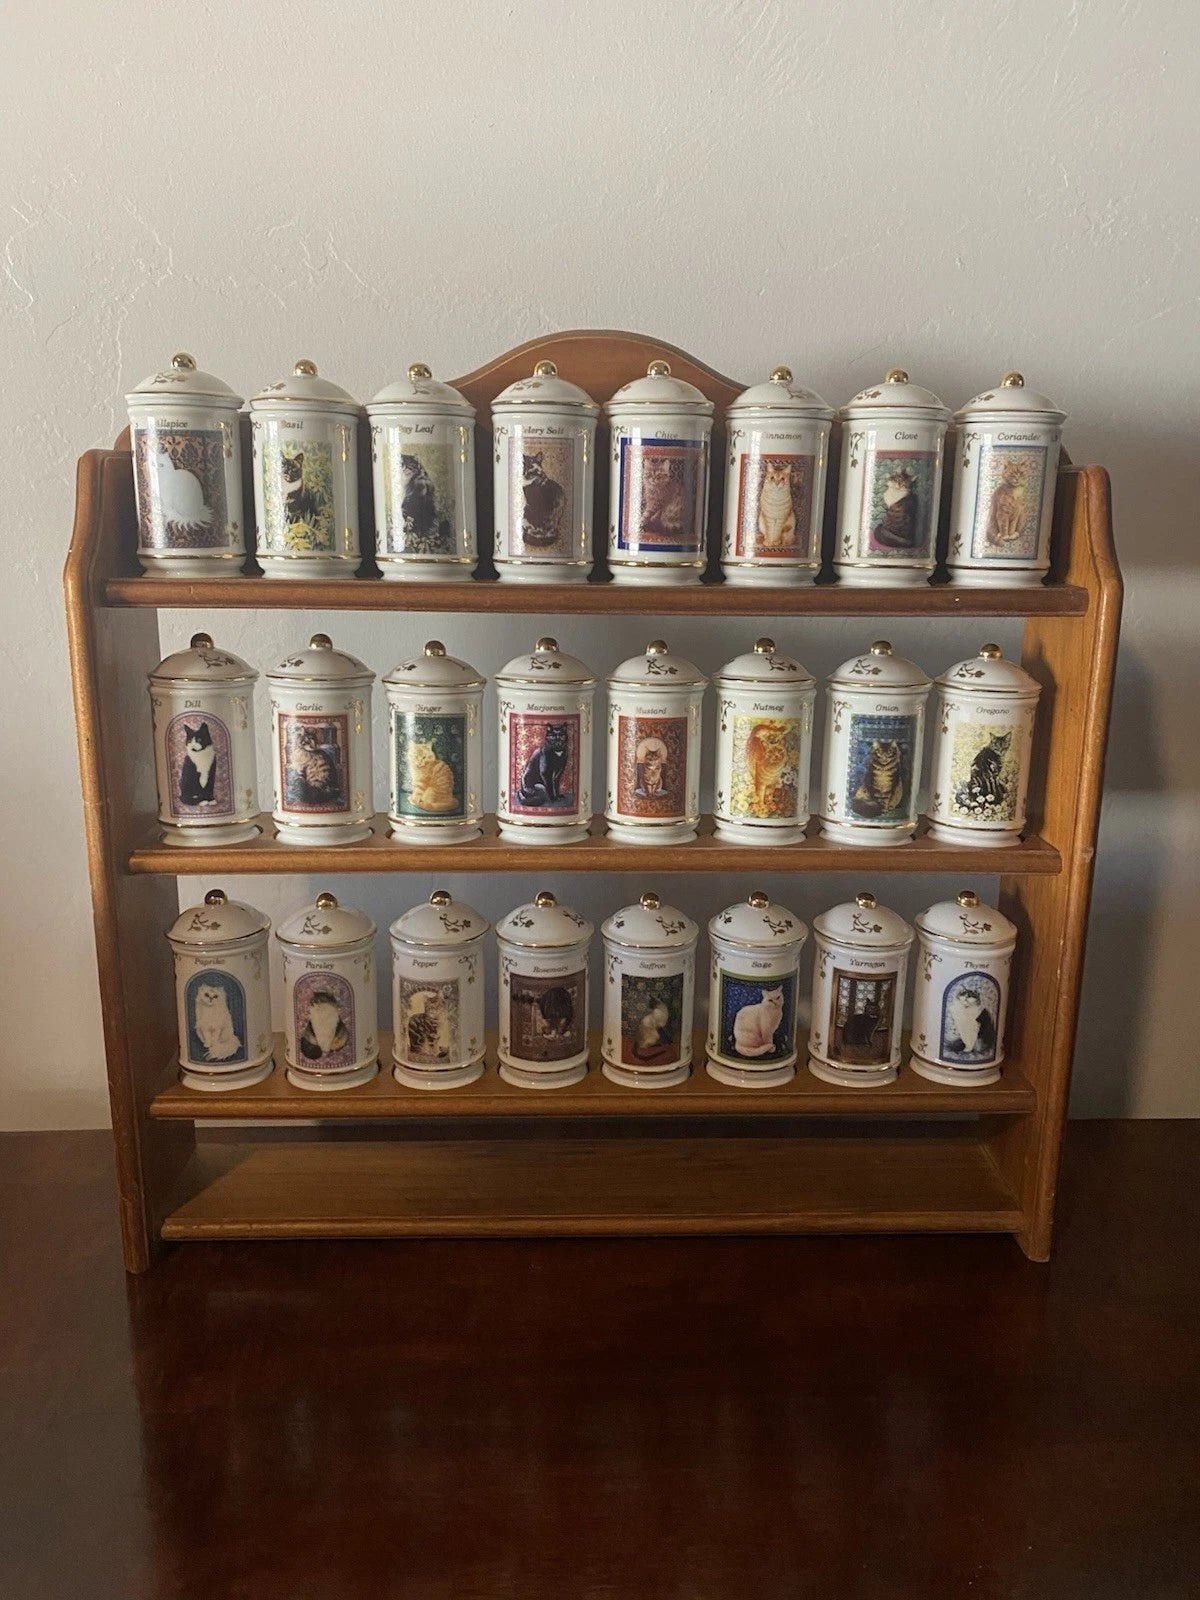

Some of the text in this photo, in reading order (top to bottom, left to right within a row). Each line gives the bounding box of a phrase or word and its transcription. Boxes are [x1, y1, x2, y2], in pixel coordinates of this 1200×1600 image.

[155, 419, 188, 430] llspice
[414, 424, 435, 435] Leaf
[522, 426, 565, 436] elery Salt
[894, 431, 919, 440] Clove
[184, 699, 202, 708] Dill
[295, 702, 324, 711] Garlic
[526, 703, 565, 713] Marjoram
[752, 703, 785, 713] Nutmeg
[875, 704, 899, 712] Onion
[975, 706, 1010, 716] Oregano
[305, 961, 335, 970] Parsley
[412, 959, 439, 969] Pepper
[639, 961, 667, 970] Saffron
[751, 960, 772, 970] Sage
[850, 958, 886, 968] Tarragon
[964, 960, 990, 970] Thyme
